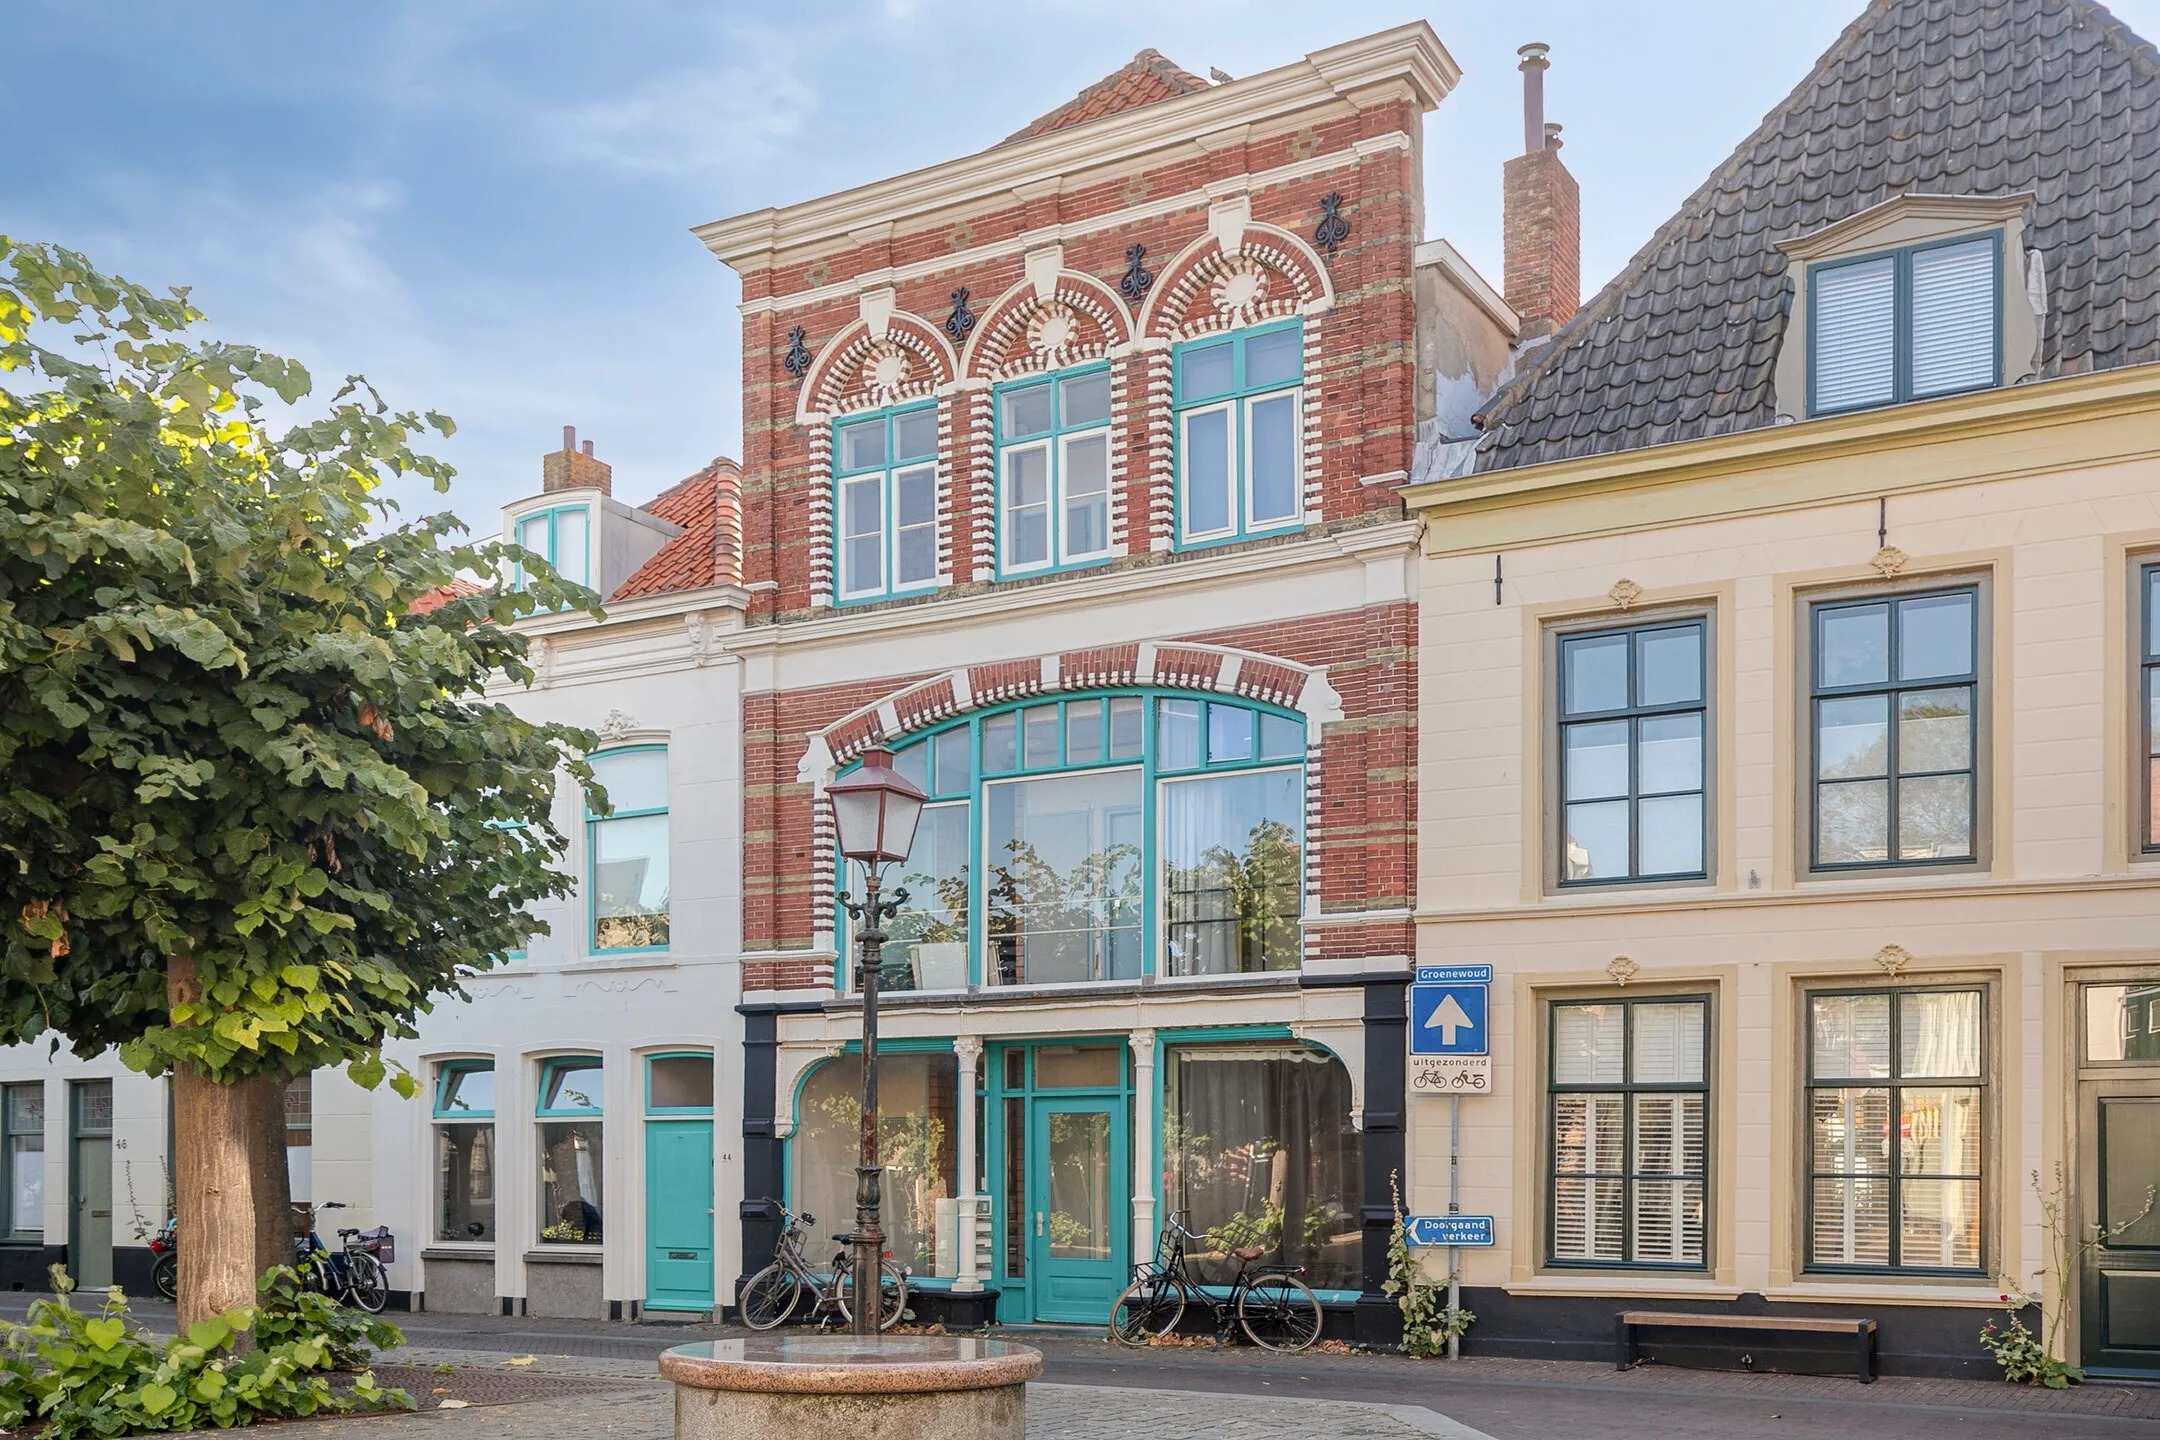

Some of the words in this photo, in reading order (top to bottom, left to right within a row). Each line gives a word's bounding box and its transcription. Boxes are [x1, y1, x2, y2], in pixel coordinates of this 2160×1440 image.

[1420, 968, 1487, 979] Groenewoud
[1413, 1058, 1487, 1068] uitgezonderd
[116, 1138, 128, 1149] 46
[722, 1153, 732, 1161] 44
[1424, 1220, 1486, 1231] Doorgaand
[1442, 1232, 1486, 1240] verkeer
